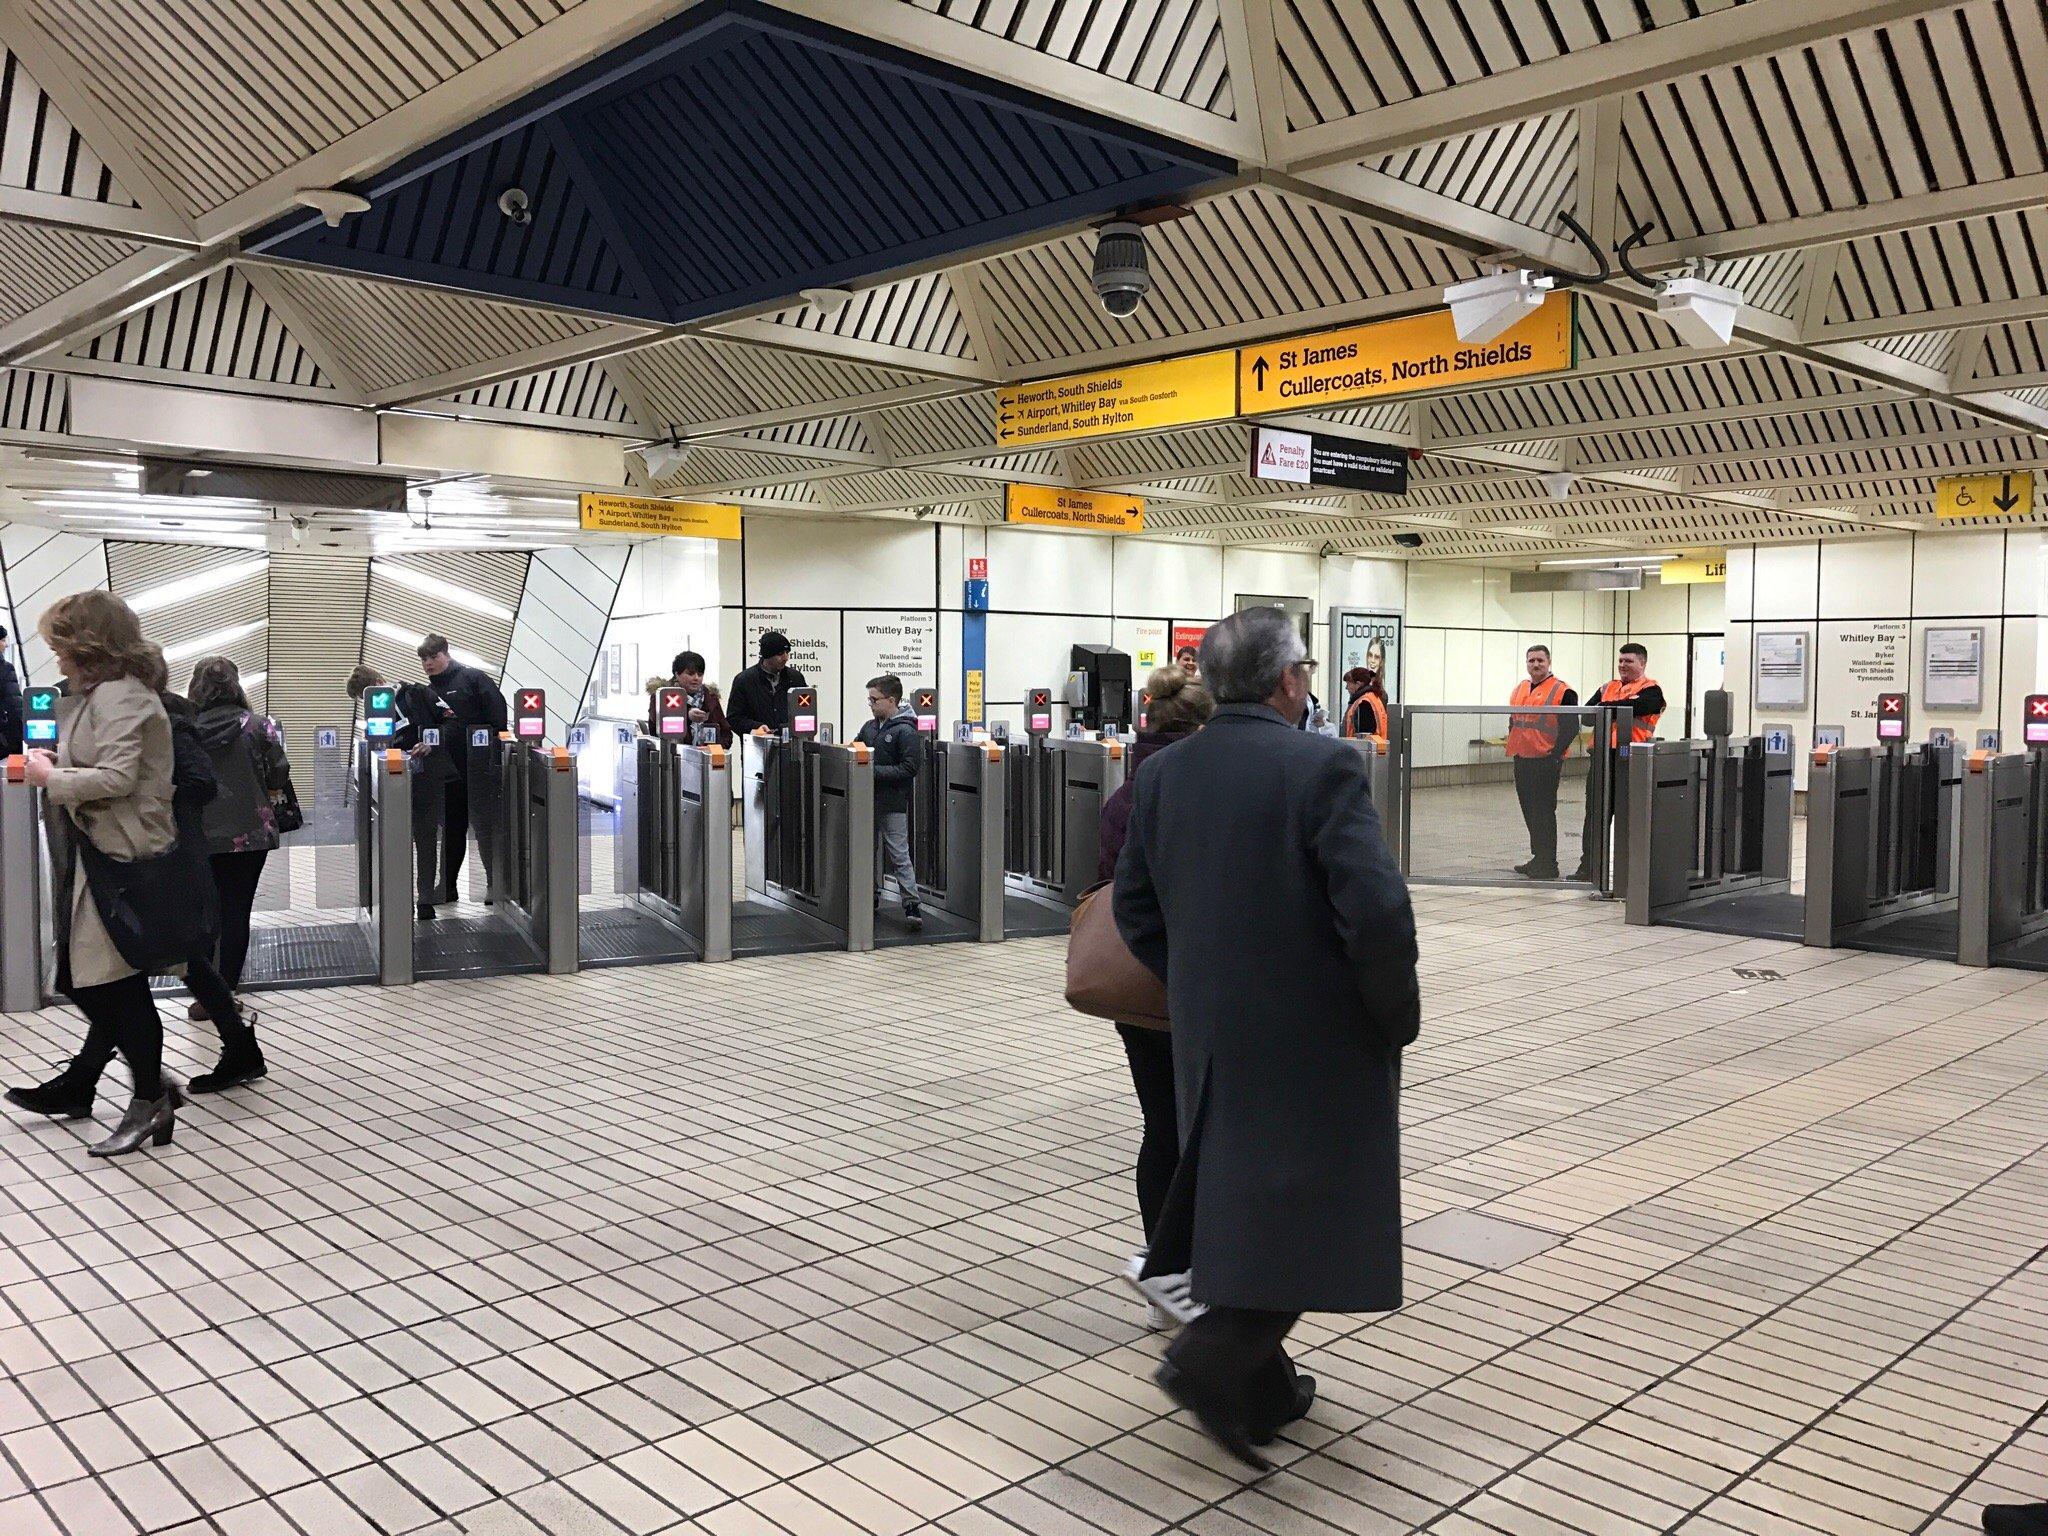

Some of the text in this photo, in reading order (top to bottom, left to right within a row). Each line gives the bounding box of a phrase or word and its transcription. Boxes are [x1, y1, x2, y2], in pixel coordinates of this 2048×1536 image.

[1279, 342, 1358, 370] St James
[1279, 341, 1532, 397] Cullercoats, North Shields
[1017, 379, 1123, 404] Heworth, South Shields
[1026, 404, 1060, 421] Airport,
[1061, 400, 1096, 415] Whitley
[1098, 396, 1116, 409] Bay
[1150, 390, 1178, 402] Gosforth
[1017, 411, 1134, 437] Sunderland, South Hylton
[1279, 443, 1306, 457] Penalty
[1279, 458, 1310, 470] Fare £20
[629, 502, 650, 511] South
[650, 504, 675, 513] Shields
[1057, 497, 1093, 510] St James
[632, 512, 657, 521] Whitley
[658, 514, 671, 523] Bay
[1072, 511, 1096, 523] North
[1096, 513, 1126, 525] Shields
[640, 522, 660, 530] South
[660, 523, 682, 533] Hylton
[866, 626, 923, 637] Whitley Bay
[789, 638, 829, 649] Shields,
[1840, 634, 1895, 643] Whitley Bay
[1140, 652, 1154, 660] LIFT
[789, 663, 822, 673] Hylton
